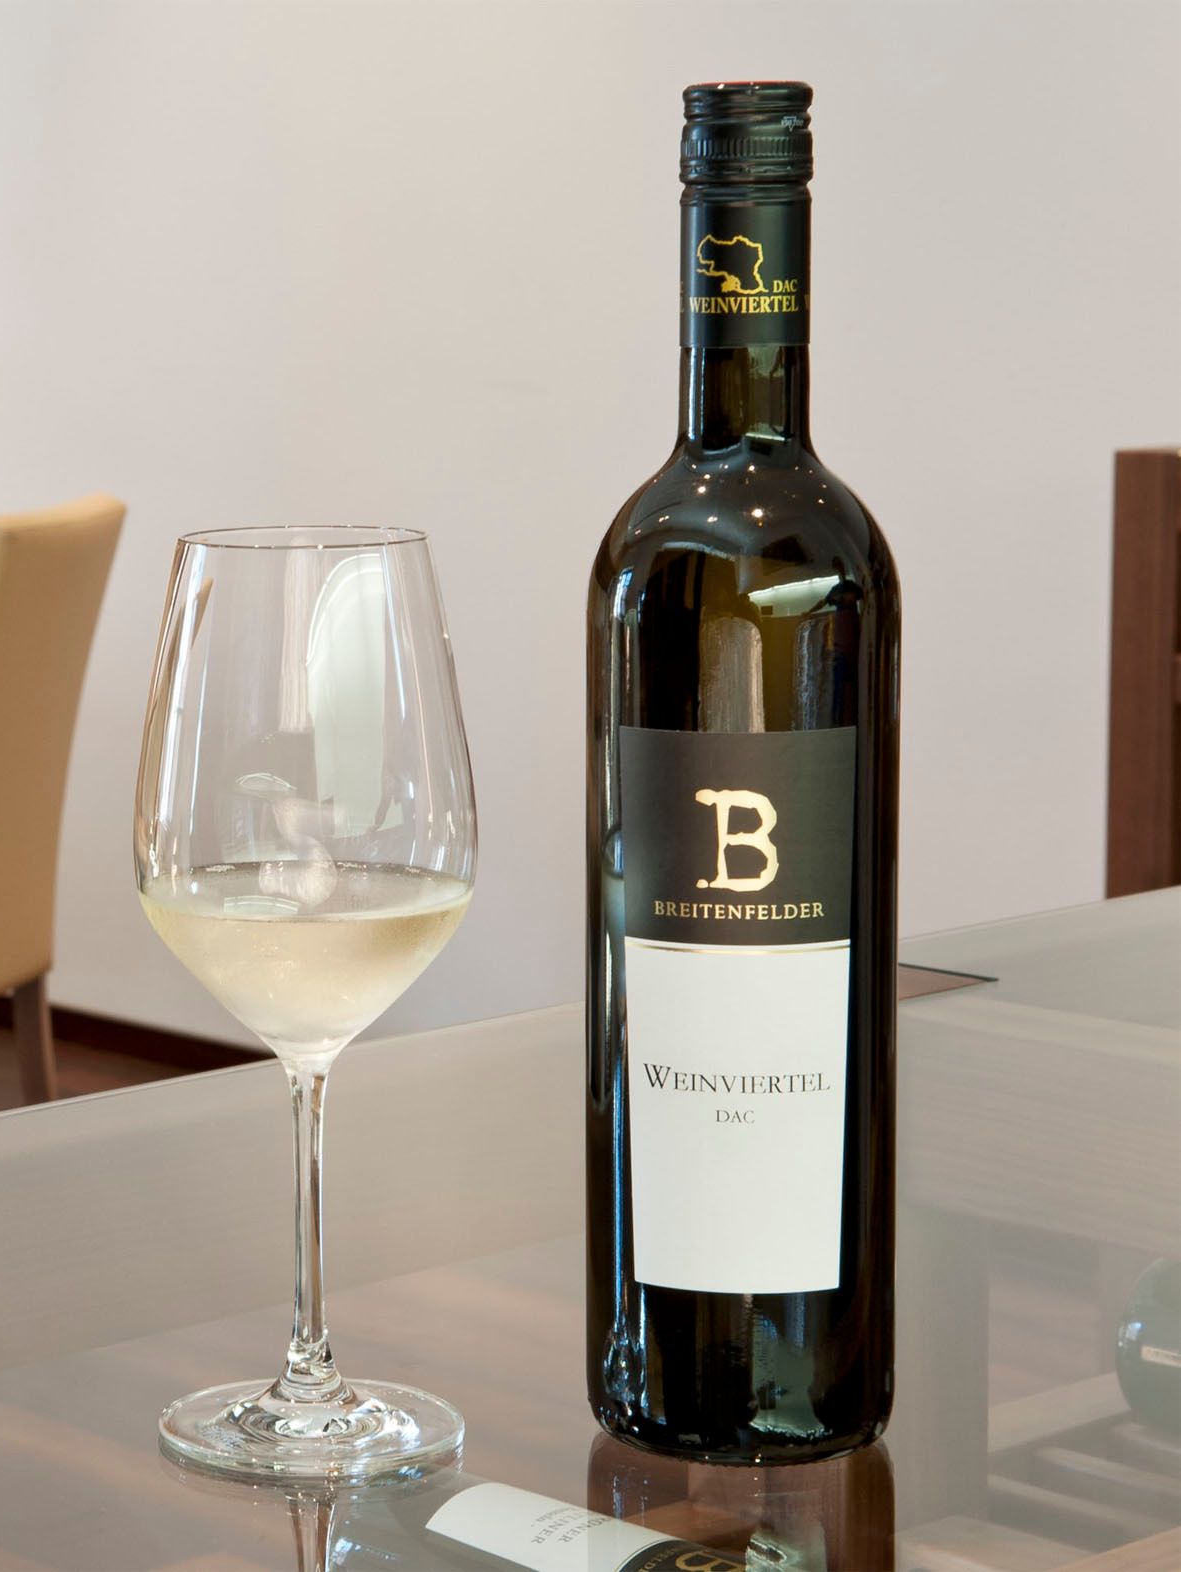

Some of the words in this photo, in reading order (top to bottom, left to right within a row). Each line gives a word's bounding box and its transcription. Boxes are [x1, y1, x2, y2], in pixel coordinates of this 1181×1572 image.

[773, 279, 798, 293] DAC
[689, 295, 799, 314] WEINVIERTEL
[695, 788, 780, 893] B
[654, 900, 825, 921] BREITENFELDER
[642, 1062, 831, 1095] WEINVIERTEL
[715, 1109, 756, 1125] DAC
